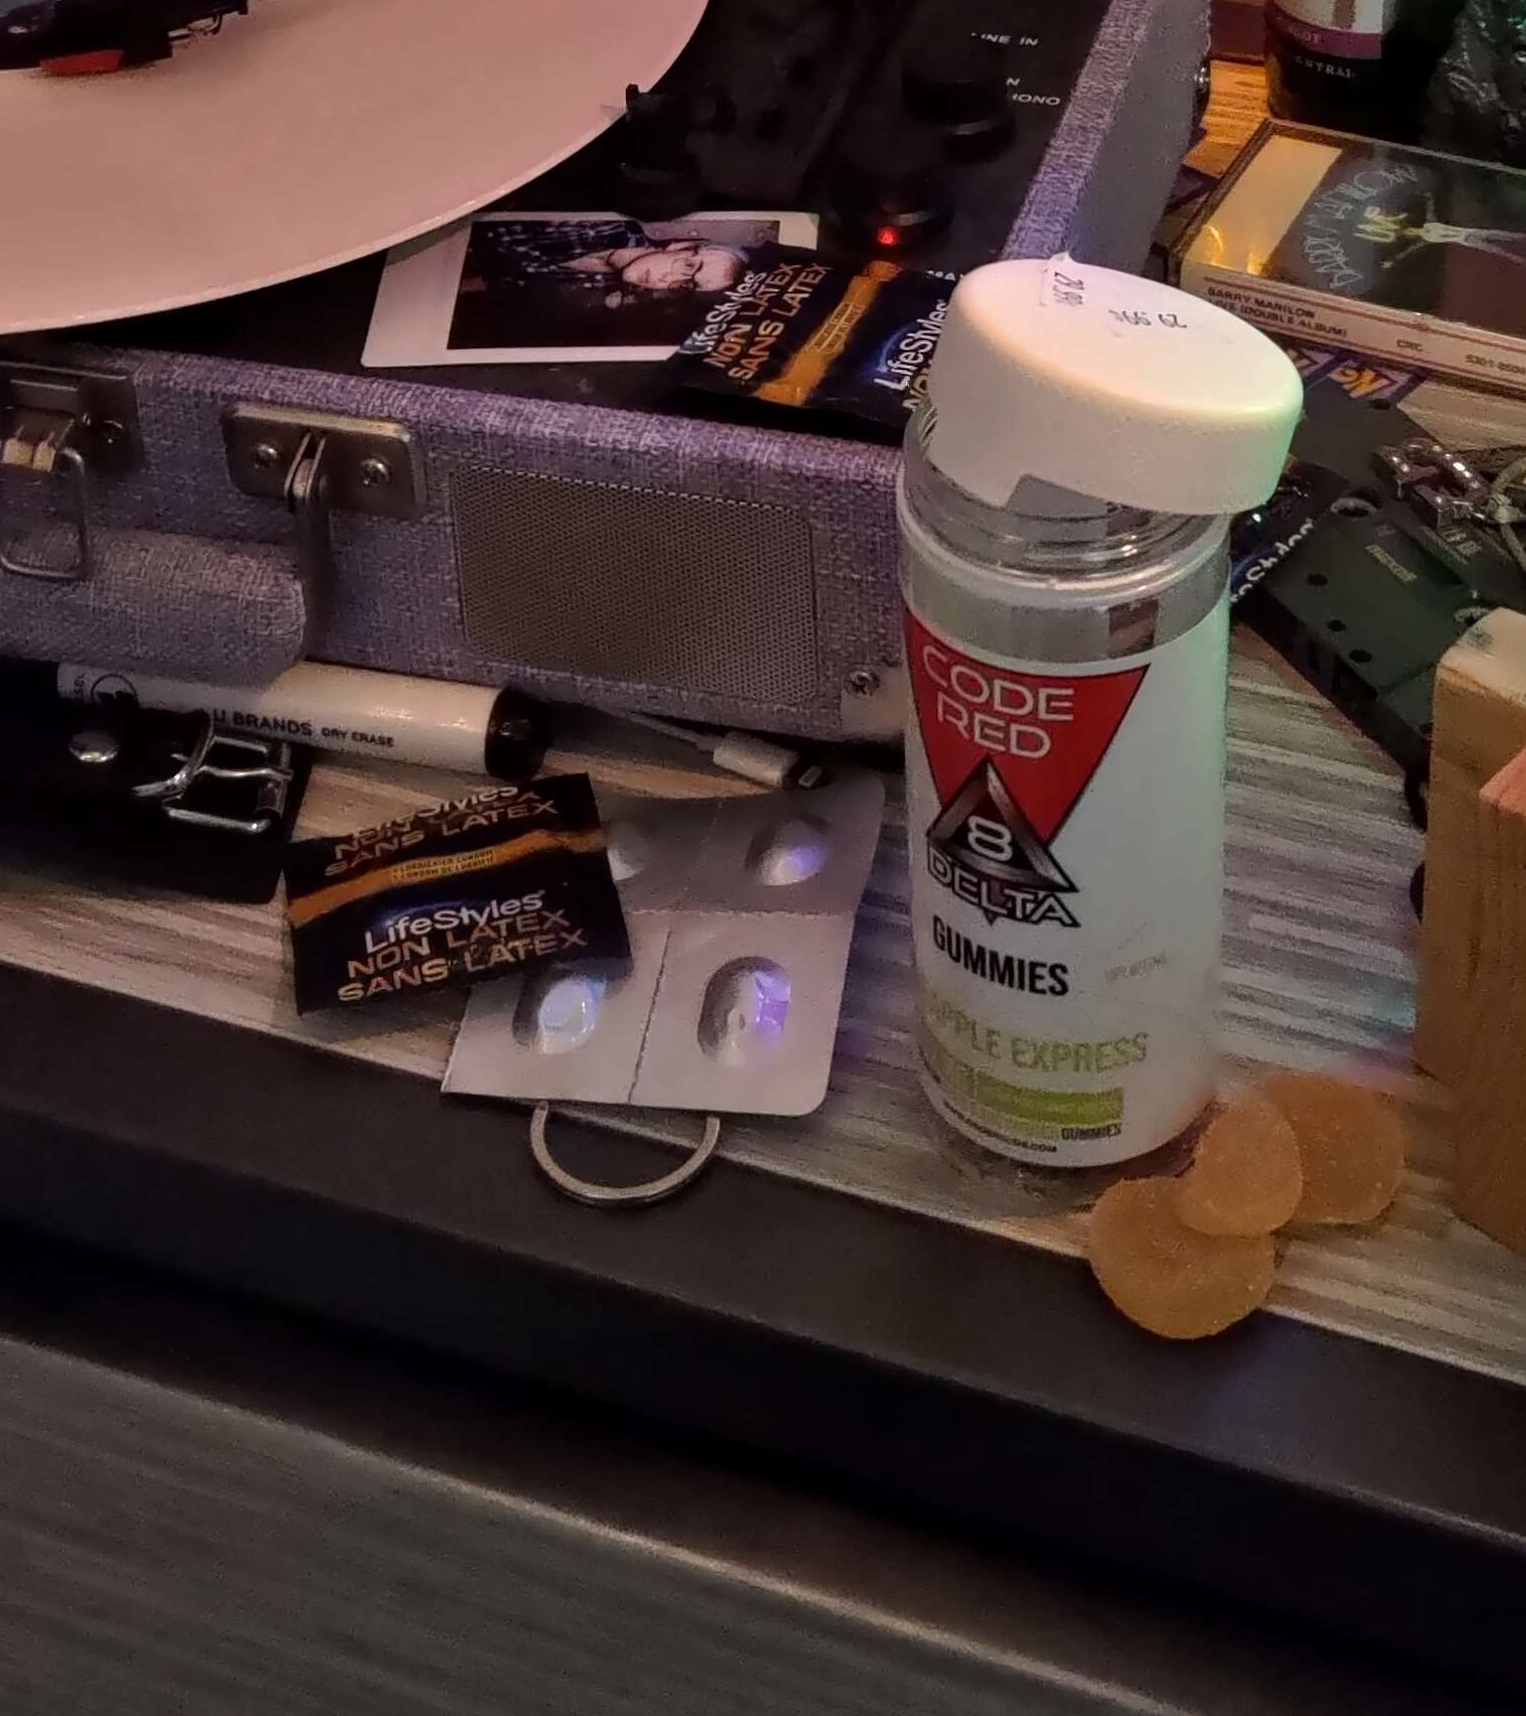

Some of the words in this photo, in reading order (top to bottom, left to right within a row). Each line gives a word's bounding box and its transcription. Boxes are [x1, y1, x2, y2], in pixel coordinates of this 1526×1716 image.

[674, 270, 768, 355] LifeStyles
[702, 322, 752, 368] NON
[739, 263, 803, 316] LATEX
[728, 319, 785, 381] SANS
[771, 262, 833, 317] LATEX
[1207, 286, 1252, 304] BARRY
[1253, 296, 1316, 320] MANILOW
[921, 644, 1075, 722] CODE
[231, 708, 314, 737] BRANDS
[320, 725, 352, 741] DRY
[353, 729, 395, 748] ERASE
[936, 691, 1053, 760] RED
[325, 829, 425, 876] SANS
[440, 800, 559, 835] LATEX
[966, 814, 1015, 863] 8
[364, 890, 543, 954] LifeStyles
[927, 850, 1081, 928] DELTA
[337, 958, 450, 1002] SANS
[464, 928, 588, 973] LATEX
[347, 936, 431, 979] NON
[446, 908, 571, 949] LATEX
[931, 914, 1070, 998] GUMMIES
[1010, 1030, 1149, 1075] EXPRESS
